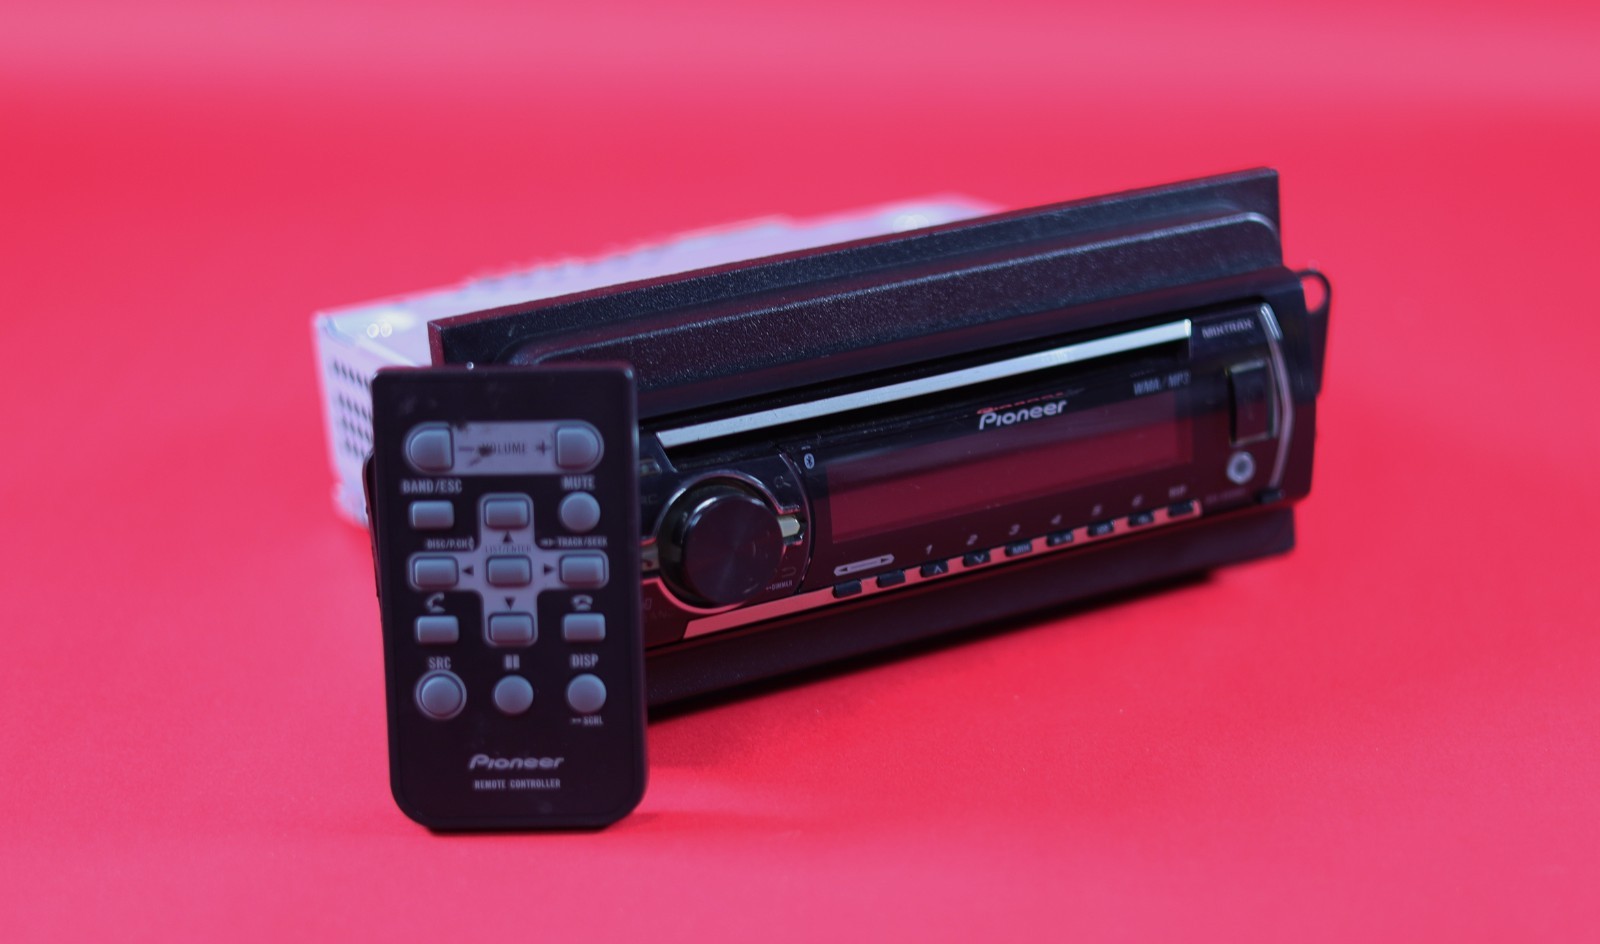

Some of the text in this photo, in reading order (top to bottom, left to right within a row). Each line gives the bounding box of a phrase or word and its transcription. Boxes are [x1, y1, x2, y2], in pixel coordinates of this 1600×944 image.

[1201, 318, 1254, 339] MIXTRAX
[979, 400, 1067, 430] Pioneer
[402, 479, 463, 494] BAND/ESC
[562, 475, 596, 490] MUTE
[1009, 524, 1020, 536] 3
[966, 533, 978, 546] 2
[926, 544, 933, 554] 1
[428, 656, 452, 670] SRC
[571, 654, 599, 668] DISP
[468, 753, 565, 770] Pioneer
[474, 778, 561, 790] REMOTE CONTROLLER
